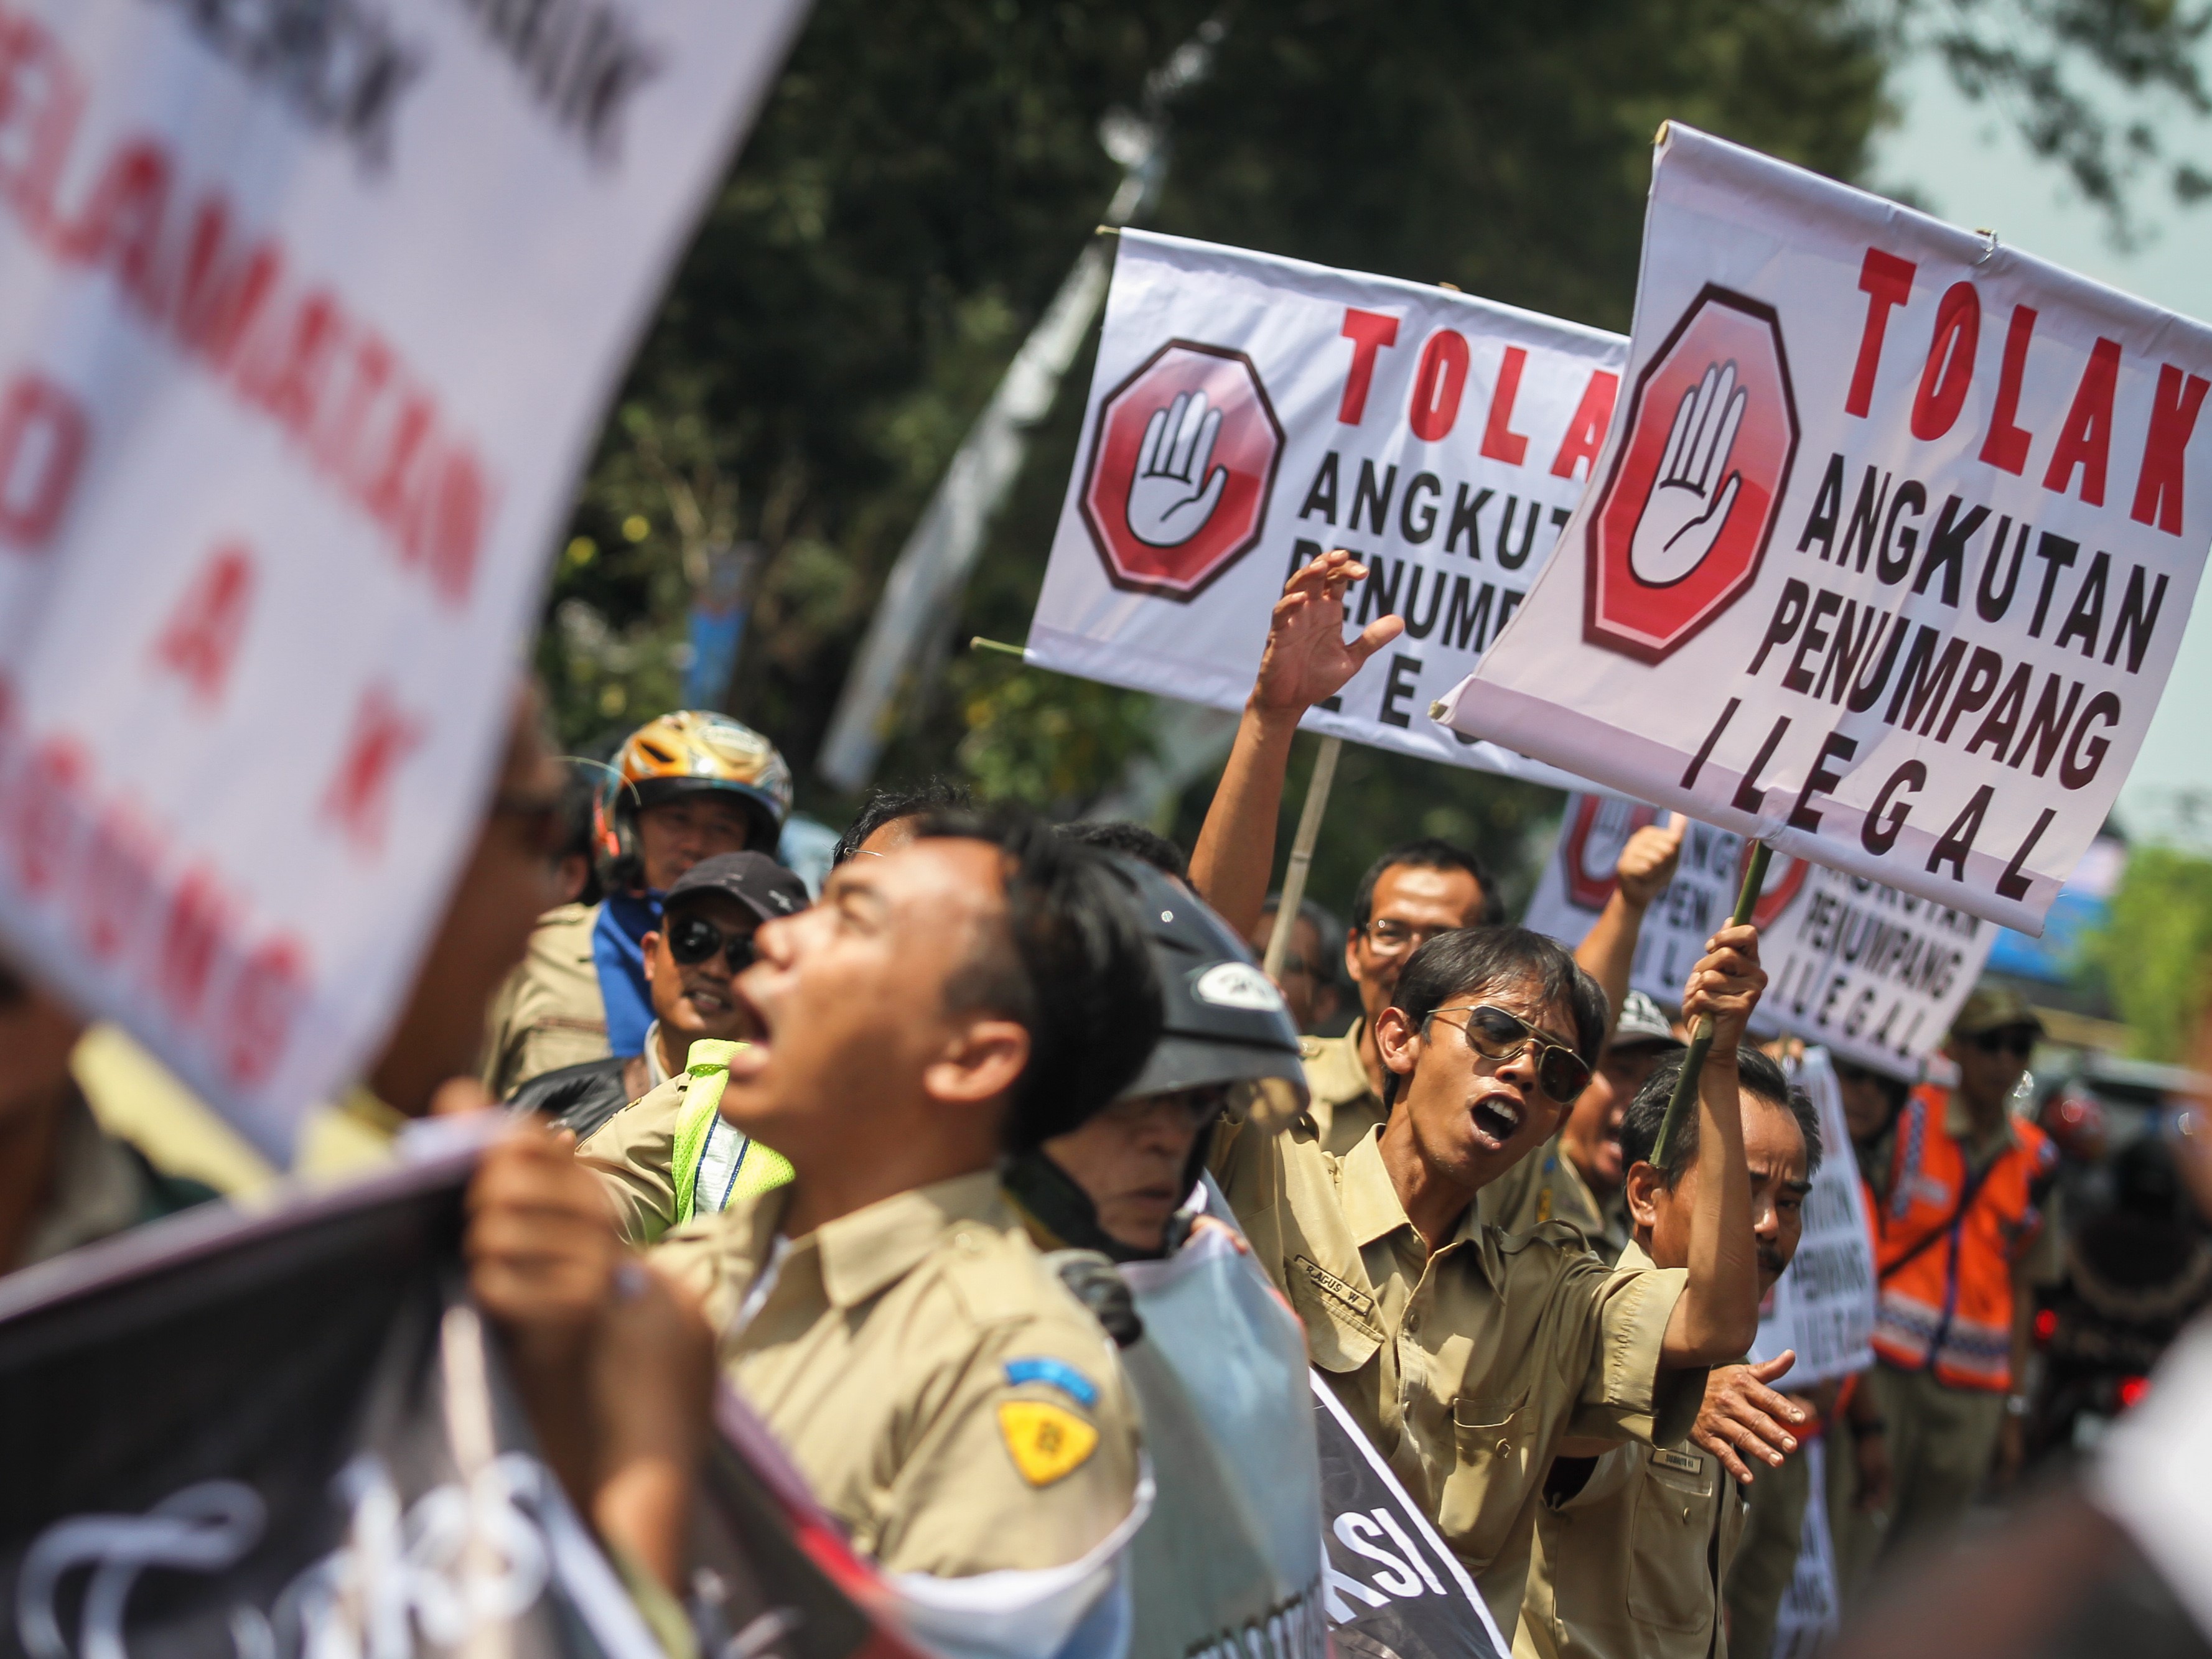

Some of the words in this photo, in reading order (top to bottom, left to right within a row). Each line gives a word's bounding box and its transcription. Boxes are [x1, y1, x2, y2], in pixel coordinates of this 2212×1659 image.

[1338, 308, 1620, 483] TOLA
[1845, 246, 2211, 537] TOLAK
[1796, 452, 2170, 674] ANGKUTAN
[1746, 577, 2121, 791] PENUMPANG
[1679, 697, 2058, 902] ILEGAL
[1347, 1291, 1360, 1303] W
